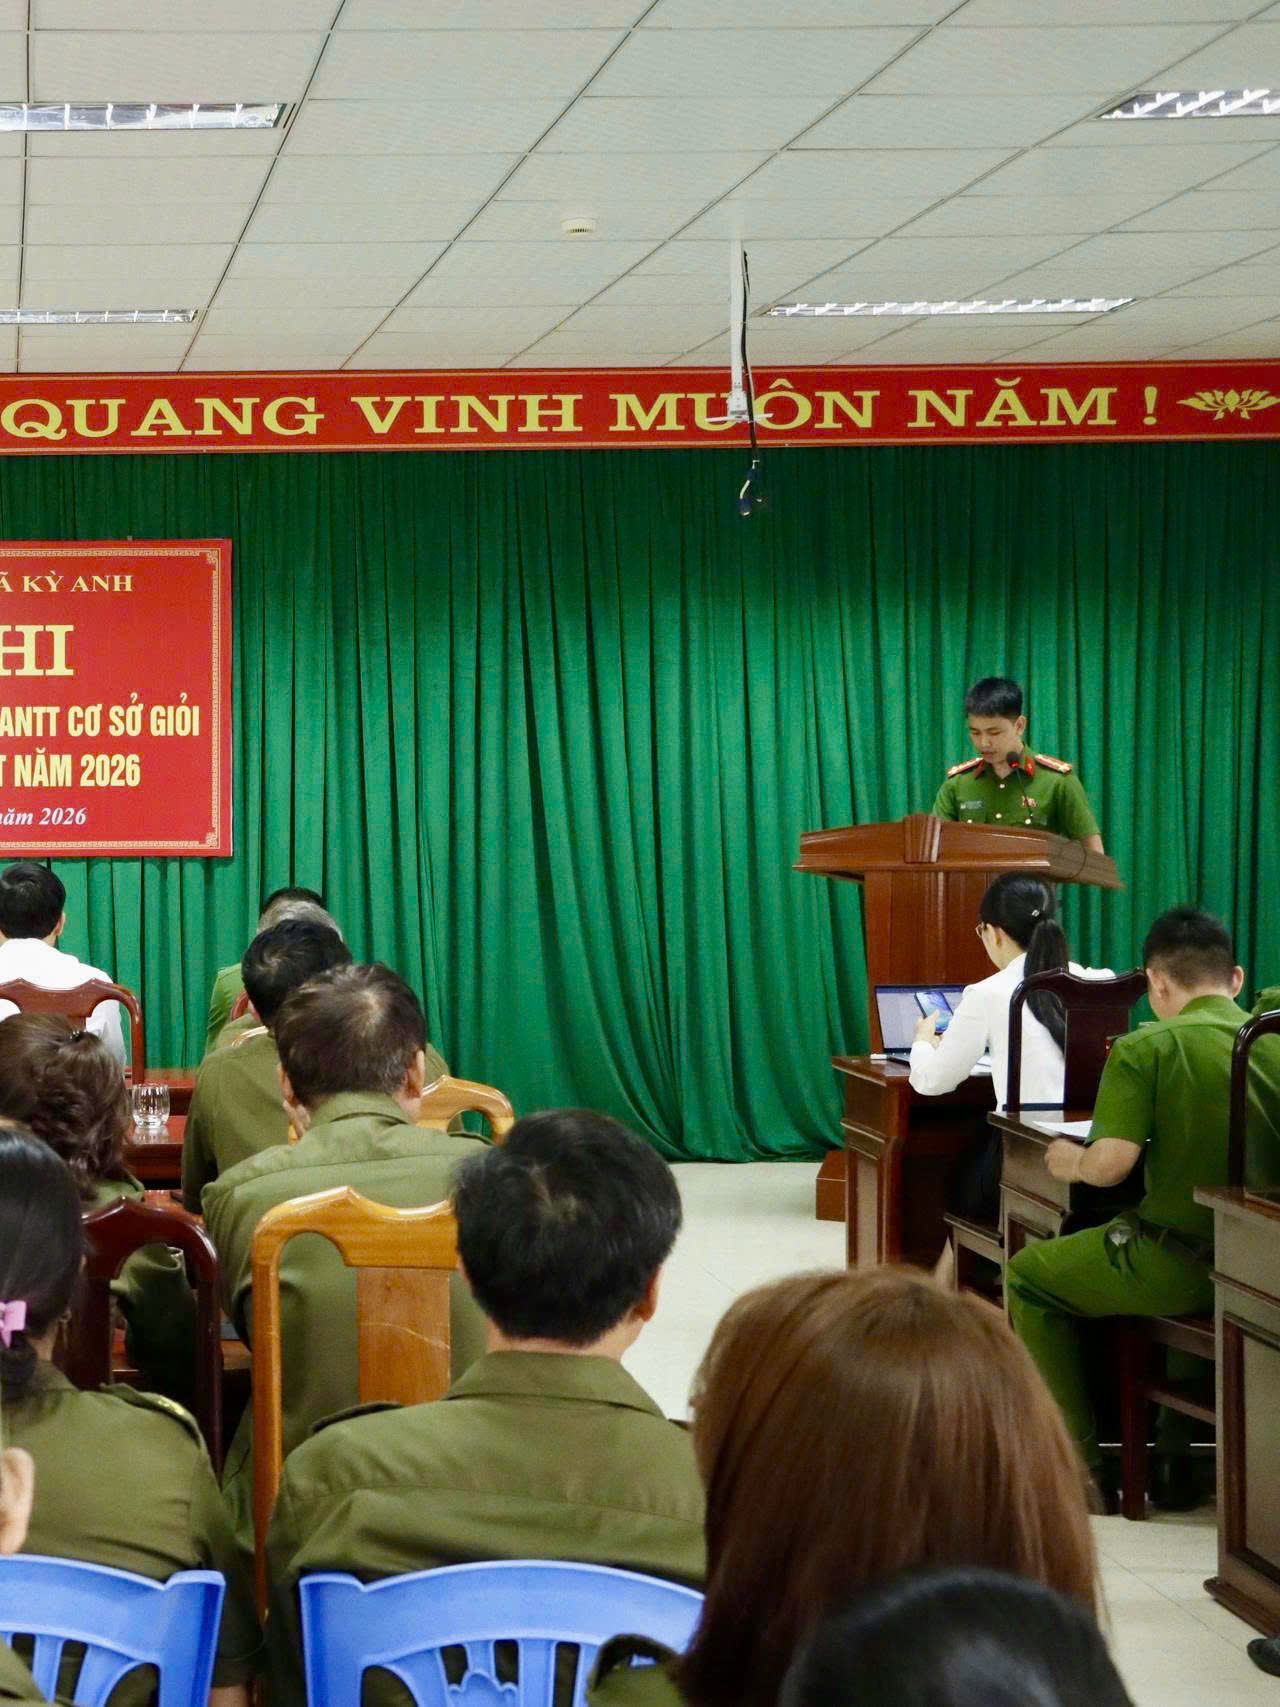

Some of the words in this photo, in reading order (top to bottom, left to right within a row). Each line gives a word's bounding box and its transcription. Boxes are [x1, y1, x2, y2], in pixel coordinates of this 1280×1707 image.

[0, 396, 325, 441] QUANG
[350, 394, 583, 434] VINH
[609, 378, 881, 432] MUÔN
[907, 377, 1117, 428] NĂM
[23, 570, 63, 593] KỲ
[71, 575, 132, 592] ANH
[67, 703, 103, 737] CƠ
[108, 692, 144, 737] SỞ
[150, 692, 200, 737] GIỎI
[14, 747, 73, 788] NĂM
[79, 753, 141, 787] 2026
[38, 807, 87, 826] 2026
